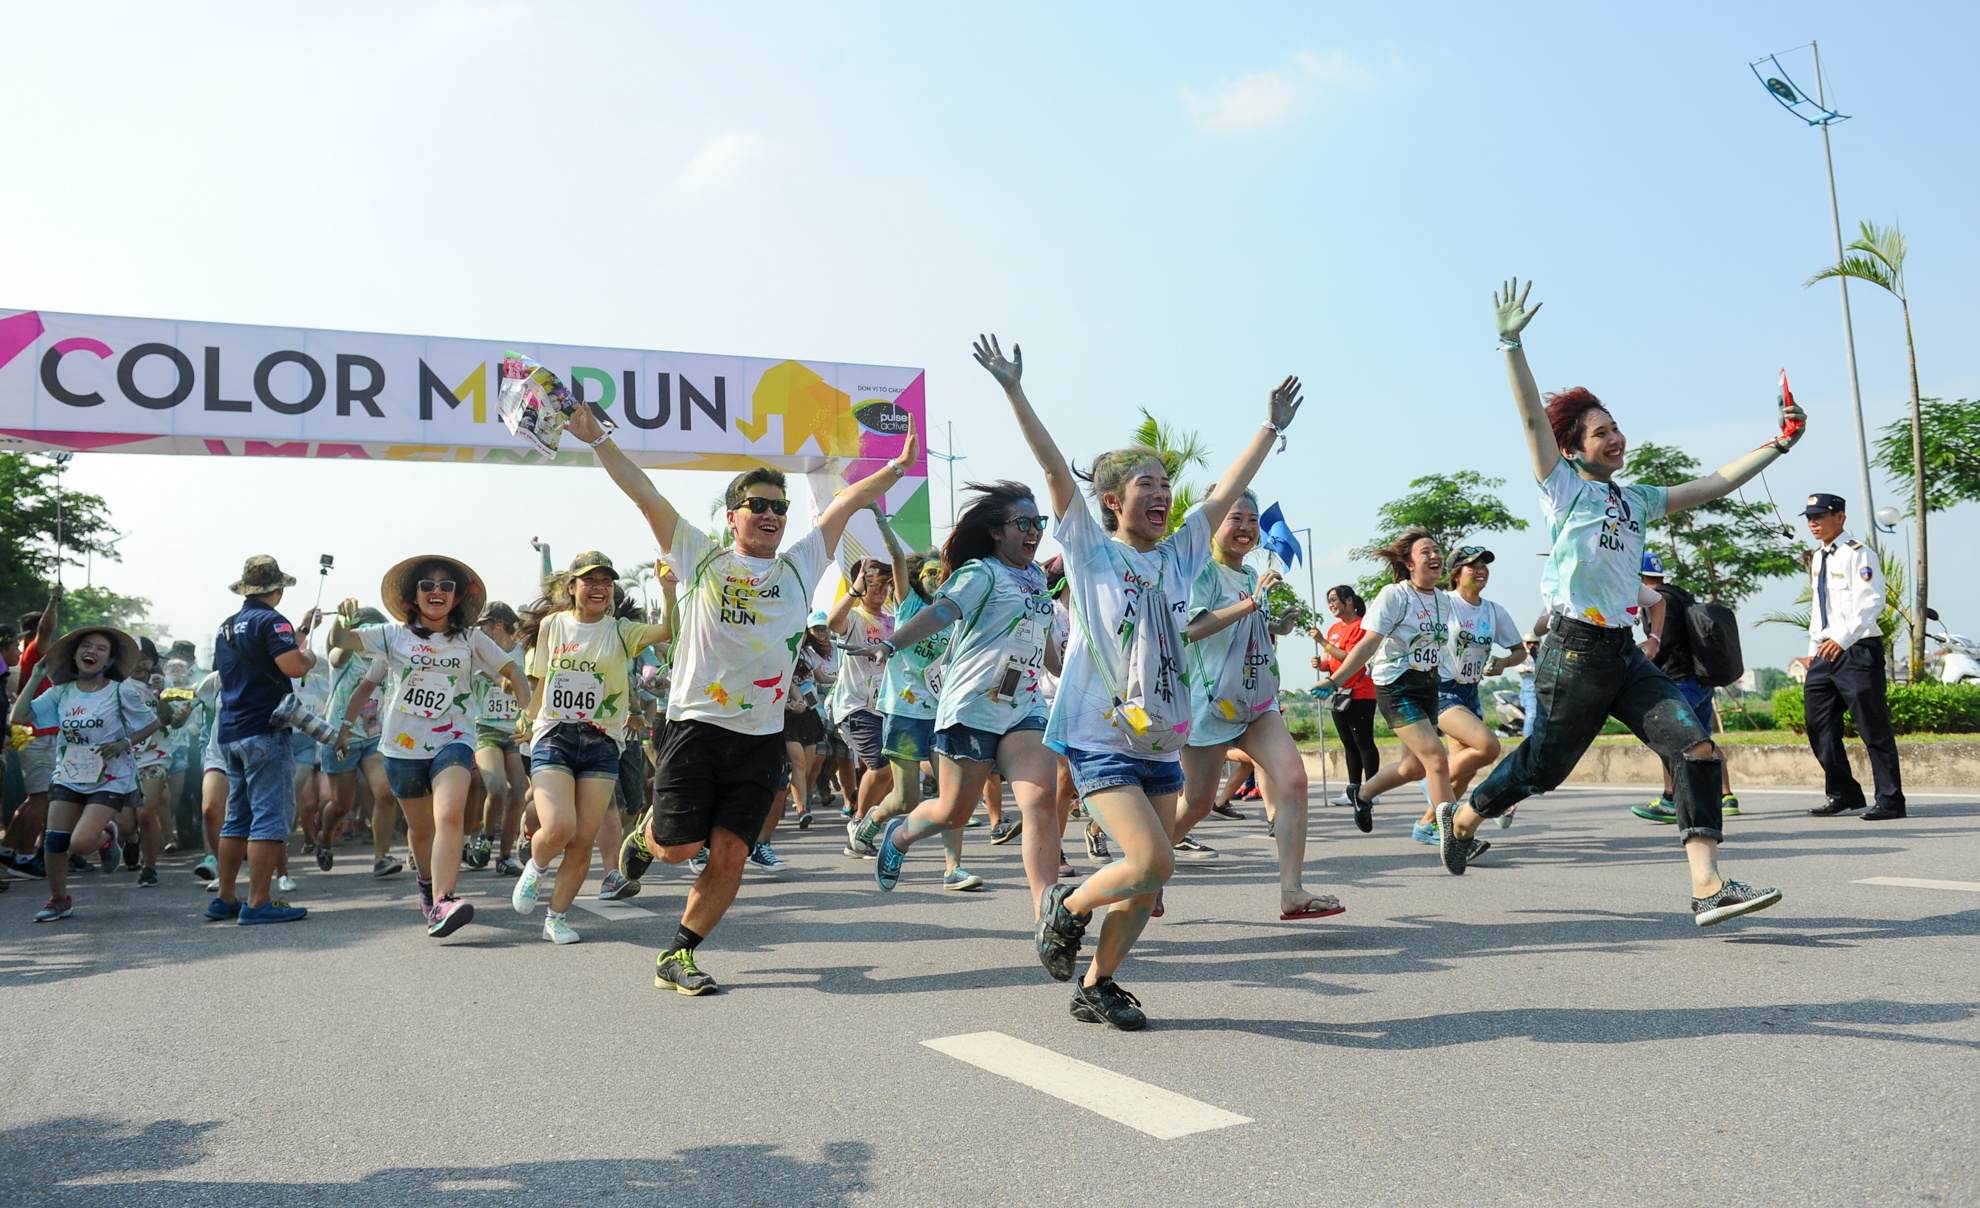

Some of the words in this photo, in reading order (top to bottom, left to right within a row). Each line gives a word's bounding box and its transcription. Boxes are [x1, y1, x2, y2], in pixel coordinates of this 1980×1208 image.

[40, 337, 387, 418] COLOR
[419, 357, 504, 425] M
[571, 366, 728, 434] RUN
[880, 403, 908, 422] pulse
[880, 422, 908, 431] active
[1599, 534, 1624, 552] RUN
[722, 594, 747, 610] ME
[720, 608, 756, 626] RUN
[1420, 622, 1448, 633] COLOR
[1458, 630, 1492, 646] COLOR
[410, 654, 460, 668] COLOR
[914, 646, 935, 660] RUN
[1414, 648, 1440, 664] 648
[551, 658, 597, 672] COLOR
[1460, 661, 1481, 677] 4818
[403, 688, 446, 710] 4662
[552, 690, 596, 710] 8046
[62, 718, 104, 729] COLOR
[62, 728, 81, 736] ME
[65, 736, 90, 745] RUN
